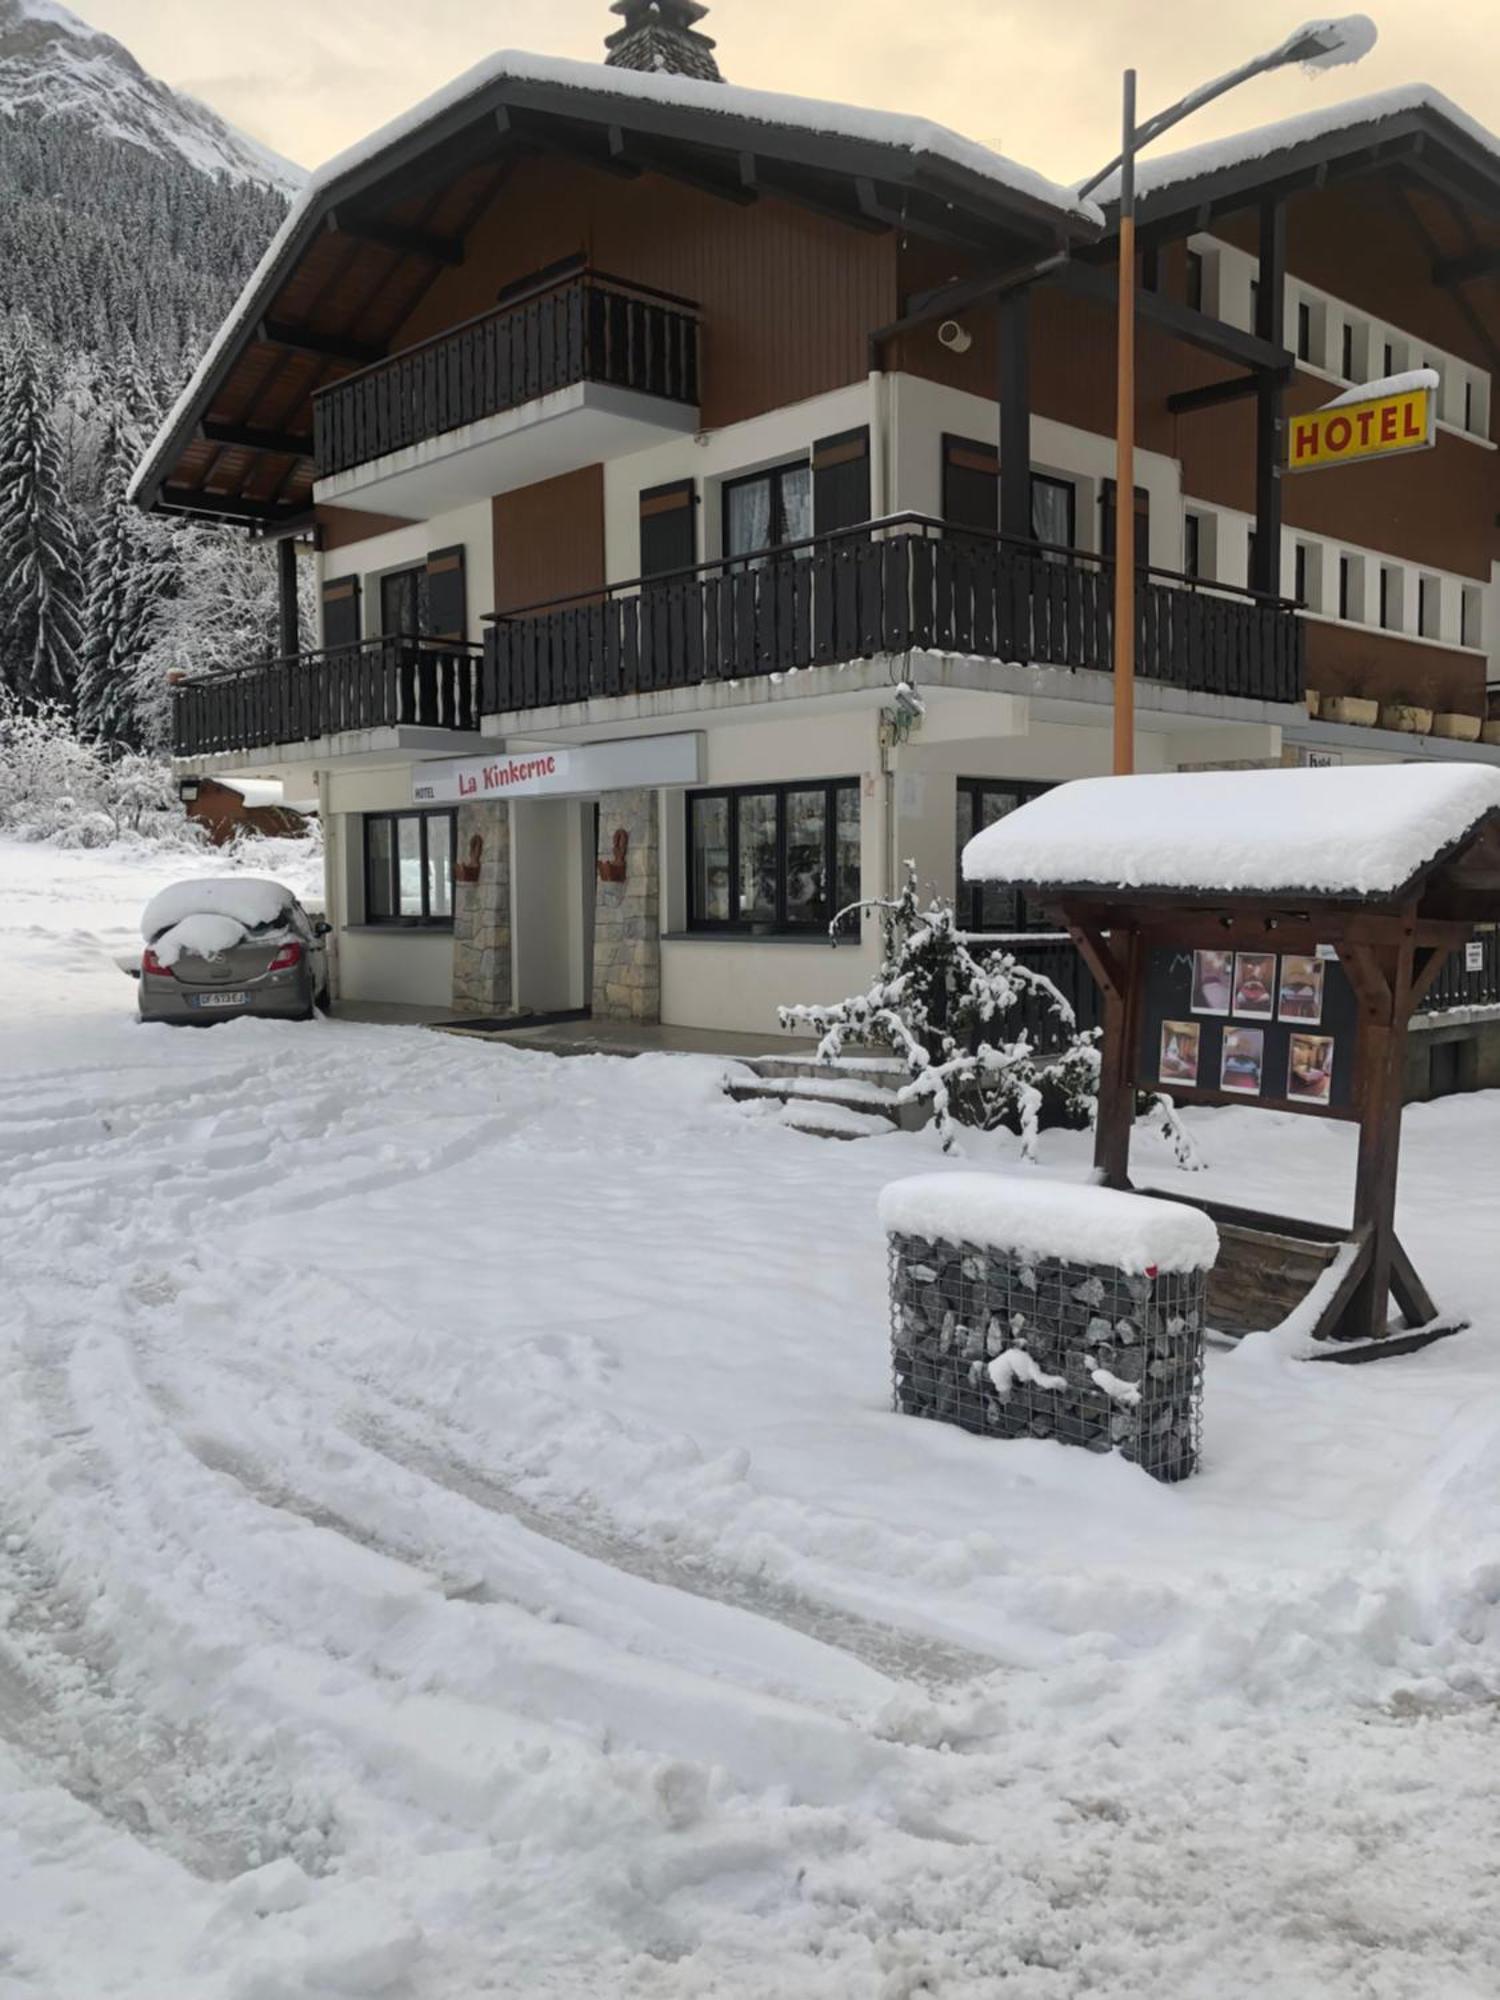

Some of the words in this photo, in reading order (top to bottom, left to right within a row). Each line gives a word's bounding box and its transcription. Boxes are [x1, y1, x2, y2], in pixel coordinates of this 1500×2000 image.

[1296, 402, 1420, 459] HOTEL
[415, 786, 435, 799] HOTEL
[458, 773, 478, 796] La
